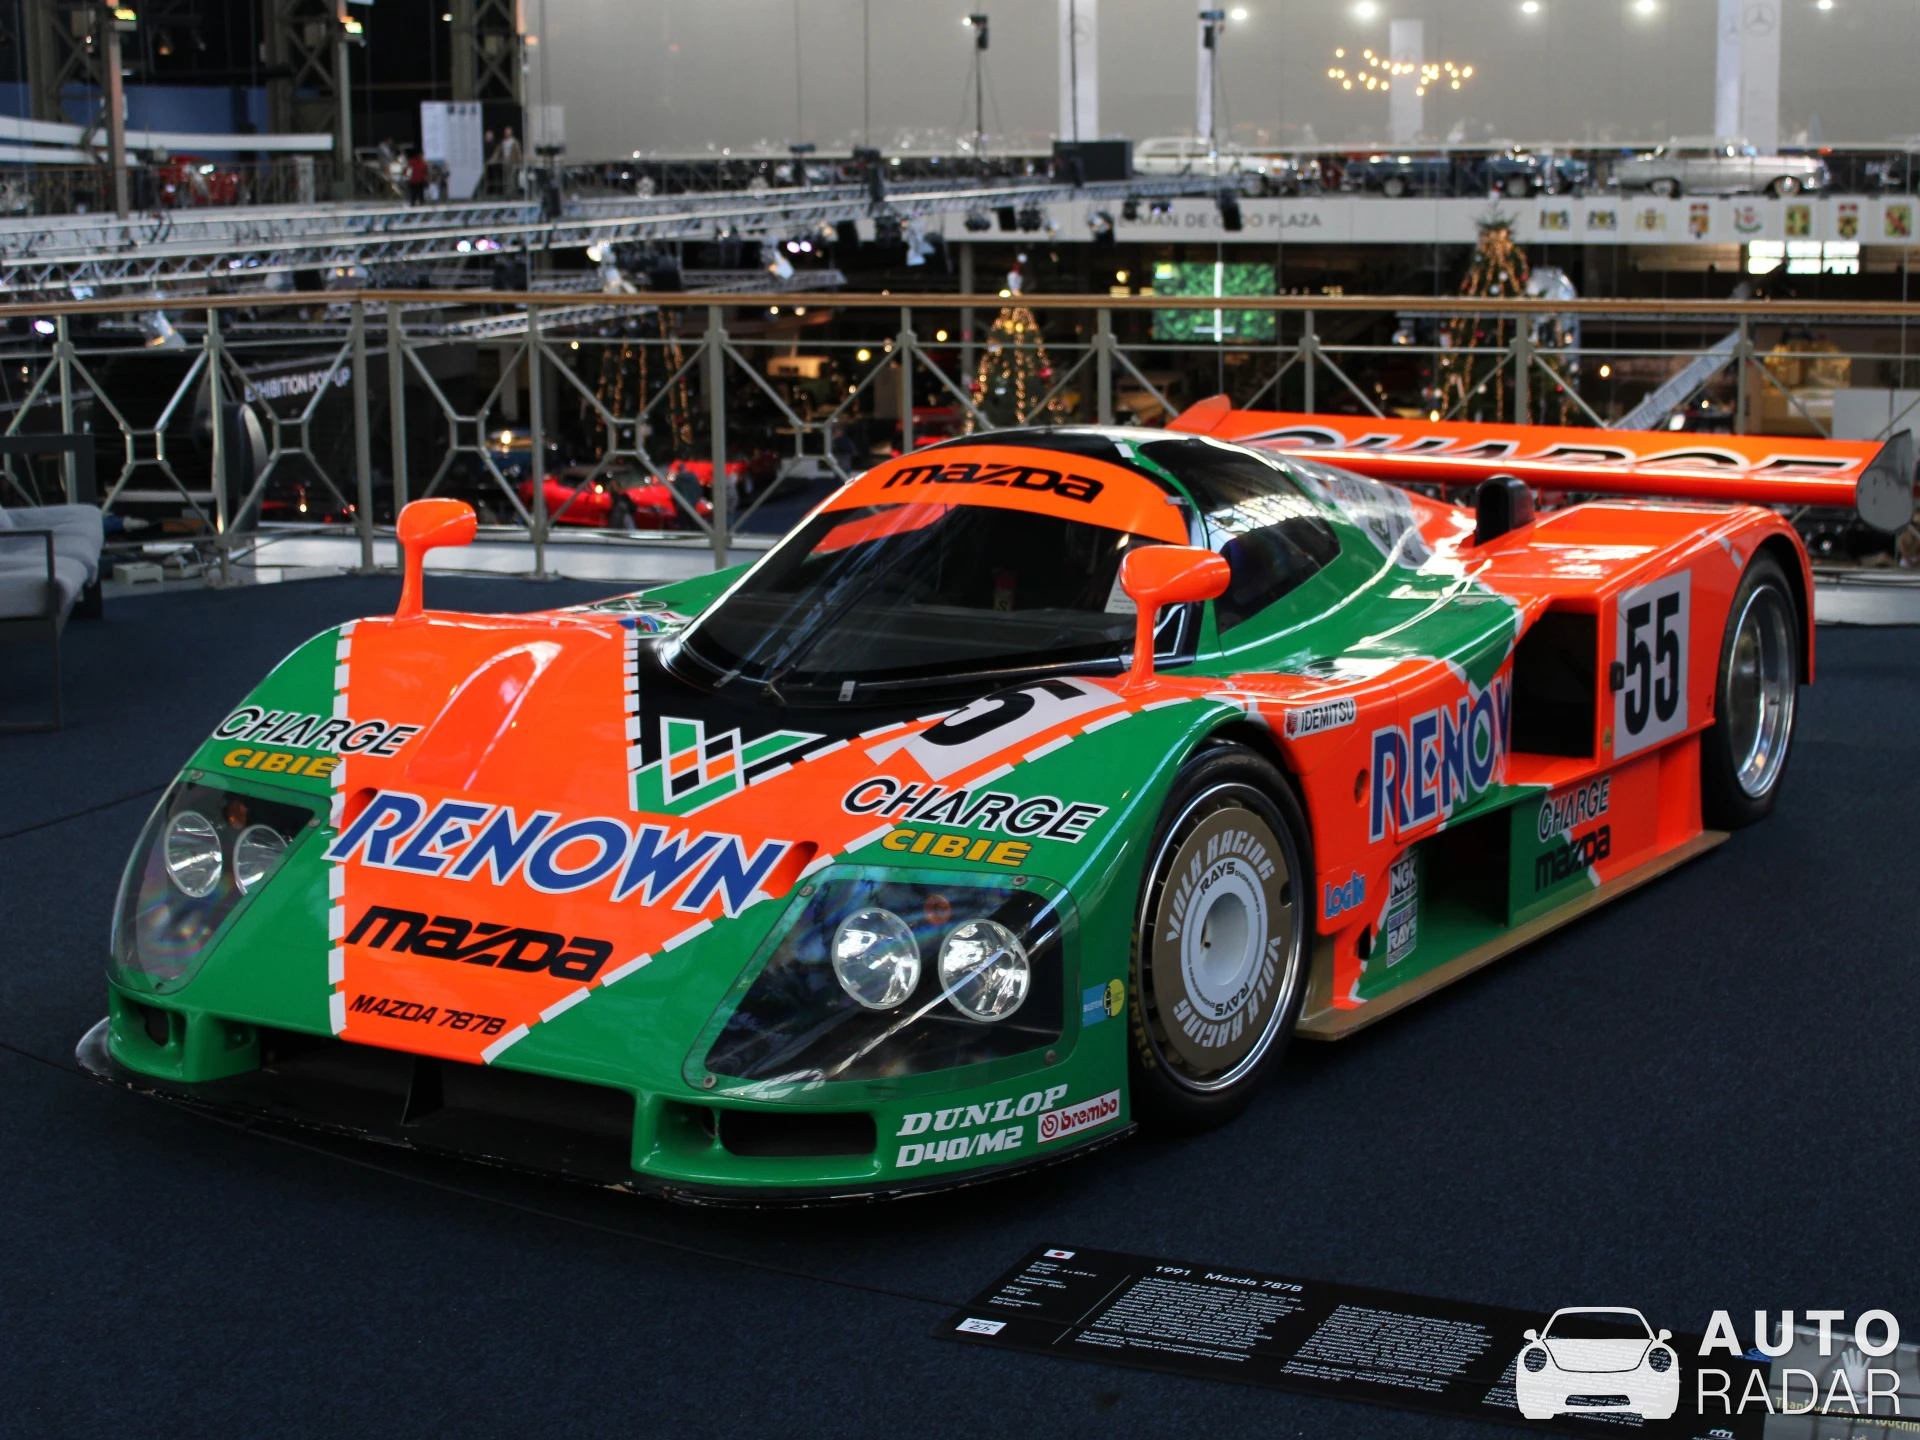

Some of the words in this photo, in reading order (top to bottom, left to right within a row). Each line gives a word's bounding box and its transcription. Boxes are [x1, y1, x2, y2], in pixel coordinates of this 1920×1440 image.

[1184, 213, 1209, 229] DE
[1267, 213, 1322, 229] PLAZA
[1624, 590, 1681, 737] 55
[213, 706, 426, 759] CHARGE
[1300, 700, 1355, 733] IDEMITSU
[840, 776, 1109, 844] CHARGE
[1537, 774, 1612, 844] CHARGE
[321, 789, 793, 919] RENOWN
[1166, 849, 1203, 942] VOLK
[1206, 829, 1276, 881] RACING
[1199, 861, 1236, 897] RAYS
[1390, 856, 1418, 897] NGK
[1387, 918, 1418, 953] RAYS
[348, 993, 439, 1025] MAZDA
[437, 1008, 508, 1036] 787B
[1214, 981, 1250, 1018] RAYS
[1172, 998, 1244, 1049] RACING
[895, 1083, 1069, 1138] DUNLOP
[1060, 1096, 1119, 1132] brembo
[895, 1125, 1024, 1169] D40/M2
[1154, 1265, 1192, 1277] 1991
[1204, 1272, 1258, 1287] Mazda
[1261, 1280, 1304, 1293] 787B
